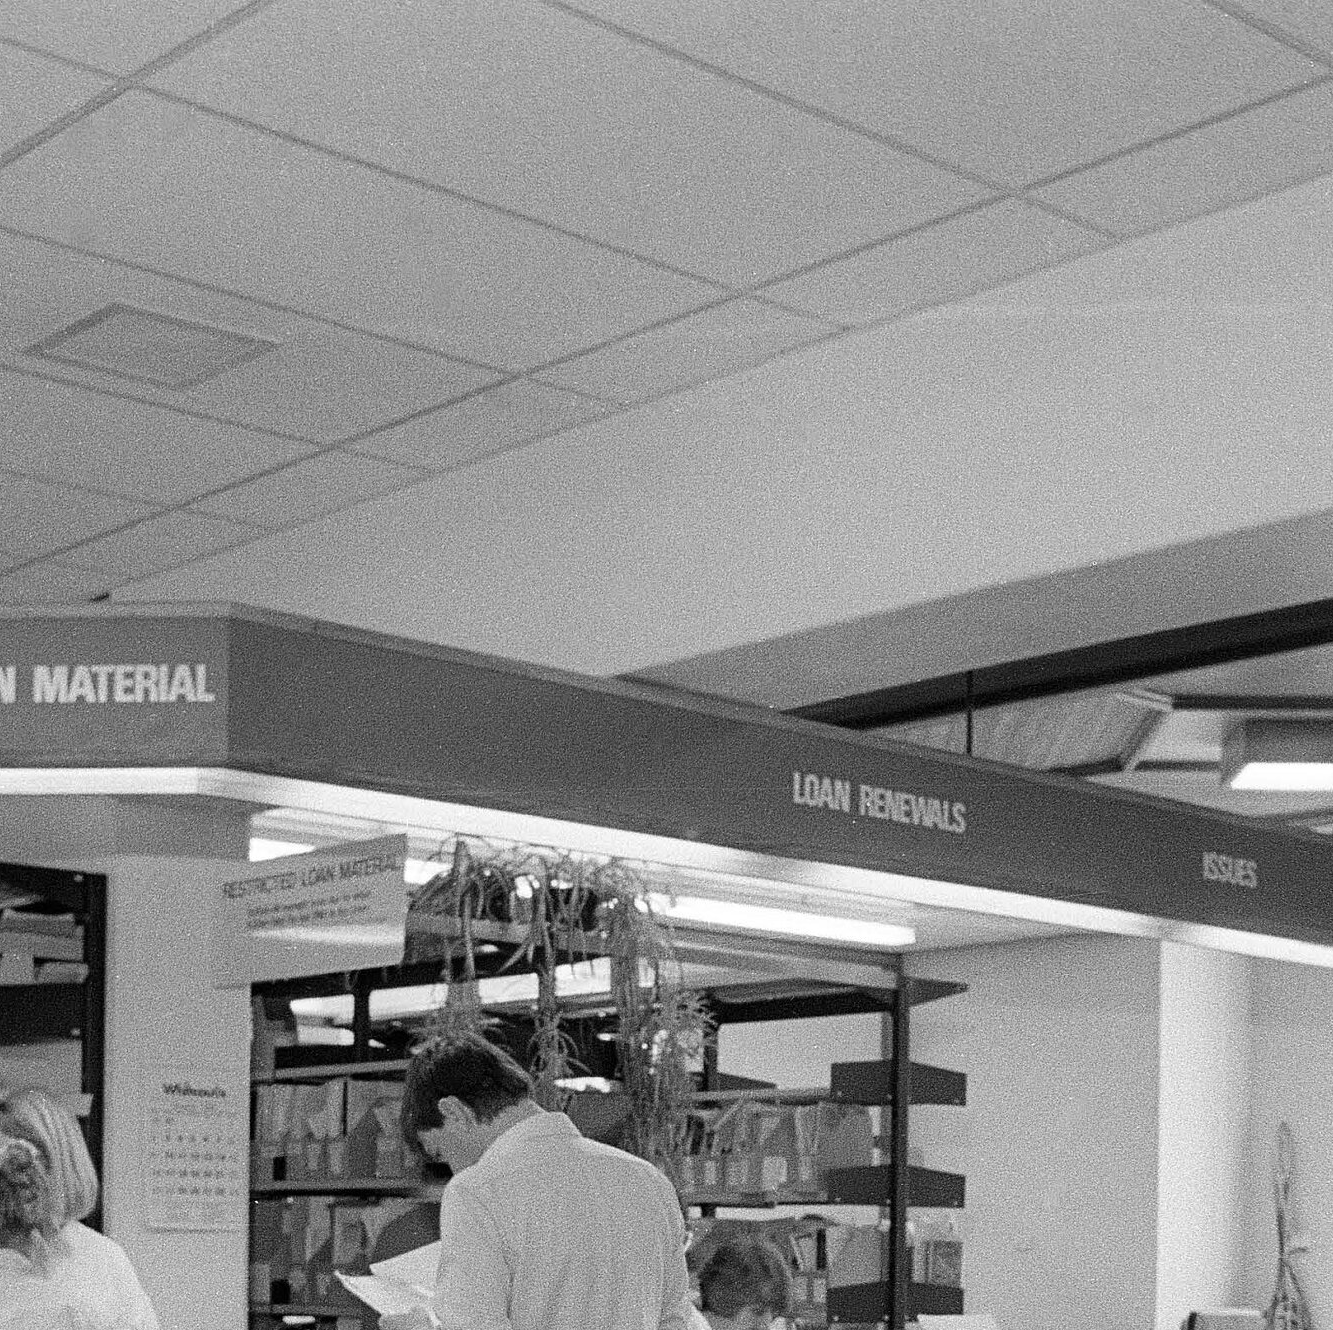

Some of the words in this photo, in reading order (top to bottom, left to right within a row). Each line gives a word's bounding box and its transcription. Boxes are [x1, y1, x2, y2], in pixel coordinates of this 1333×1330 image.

[32, 663, 215, 703] MATERIAL
[792, 772, 851, 813] LOAN
[859, 785, 966, 834] RENEWALS
[301, 865, 336, 888] LOAN
[1202, 851, 1258, 888] ISSUES
